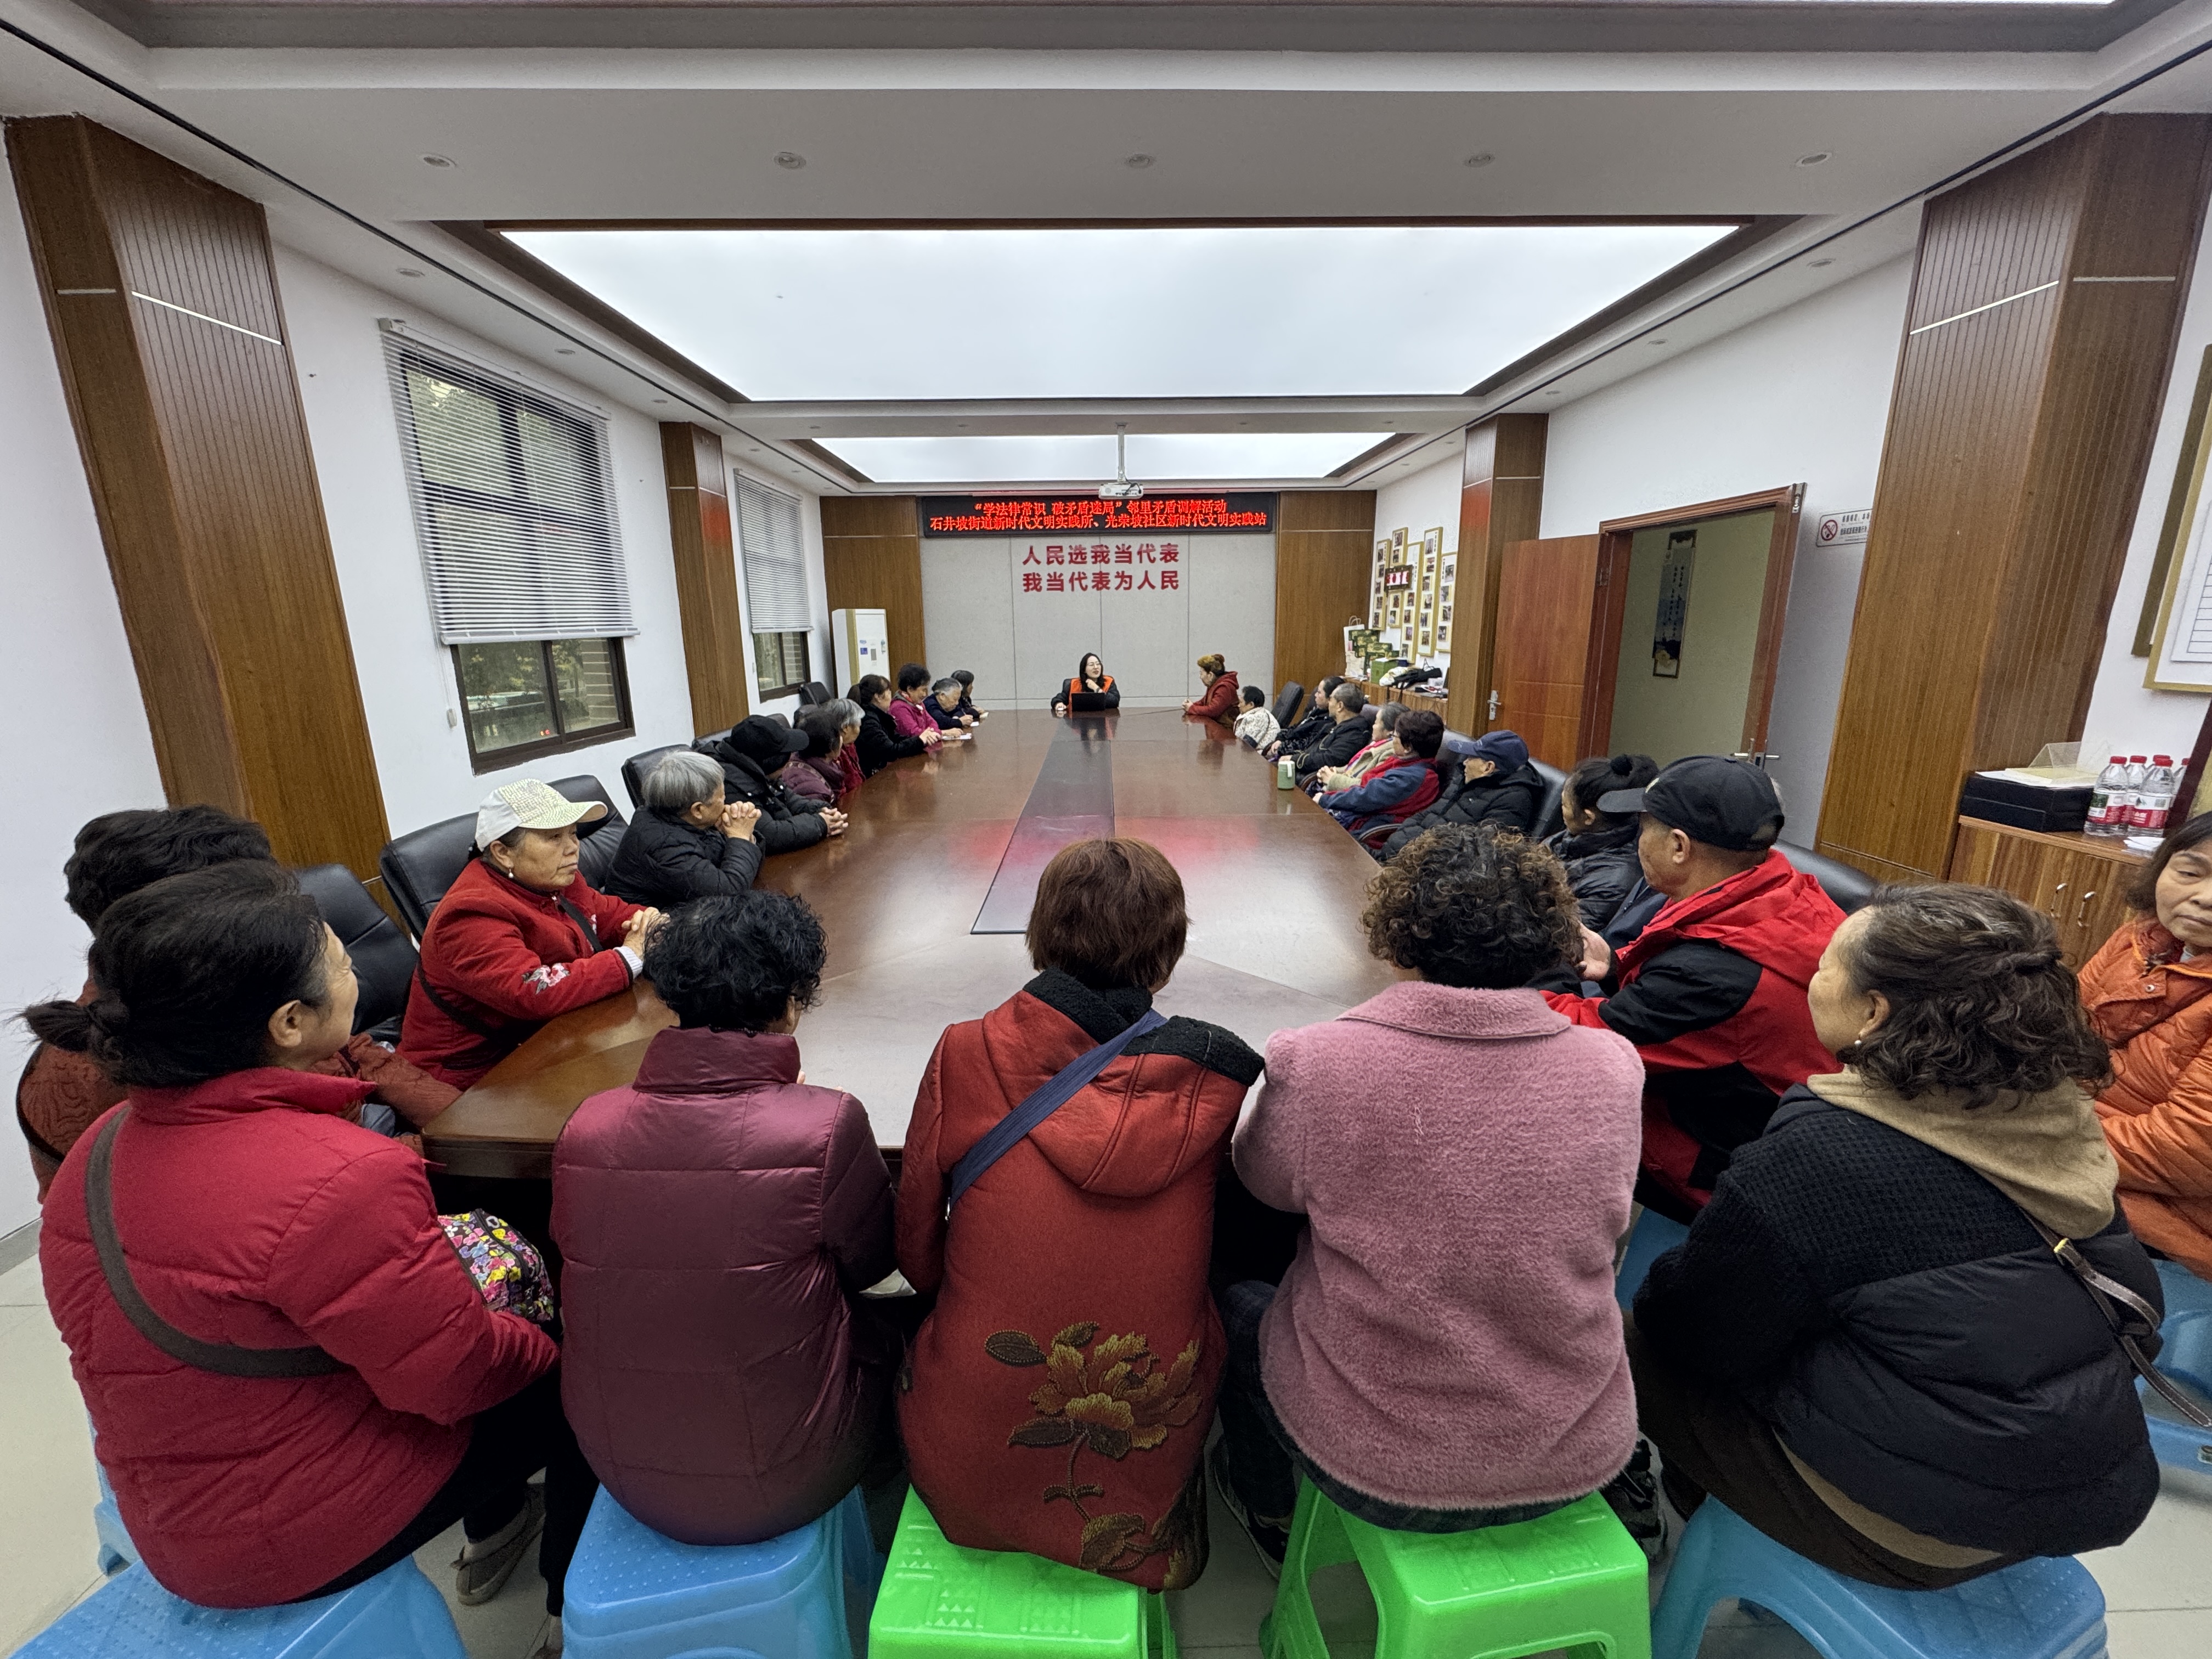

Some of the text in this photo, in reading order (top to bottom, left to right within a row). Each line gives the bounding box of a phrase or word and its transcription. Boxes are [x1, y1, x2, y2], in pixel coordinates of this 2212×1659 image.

[1022, 543, 1179, 566] 人民选我当代表
[1022, 570, 1179, 592] 我当代表为人民
